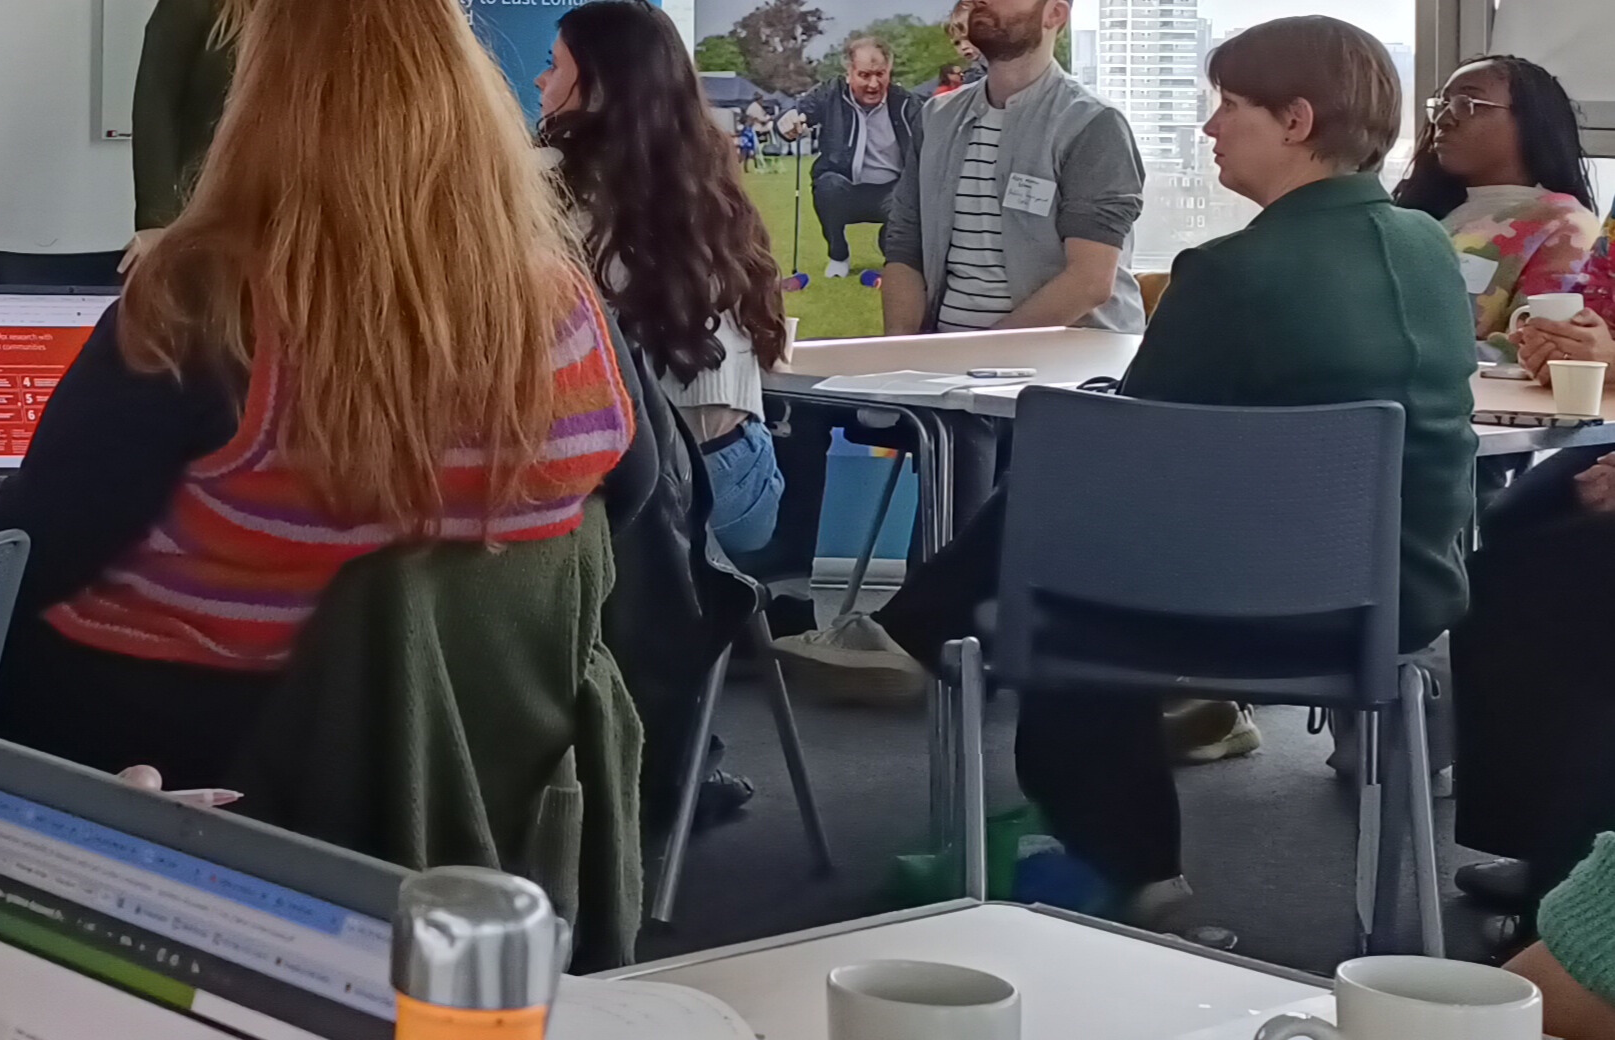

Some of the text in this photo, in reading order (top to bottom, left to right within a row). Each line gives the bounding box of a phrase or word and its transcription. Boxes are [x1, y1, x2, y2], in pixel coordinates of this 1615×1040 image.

[23, 377, 31, 387] 4
[25, 393, 33, 403] 5
[27, 410, 36, 420] 6
